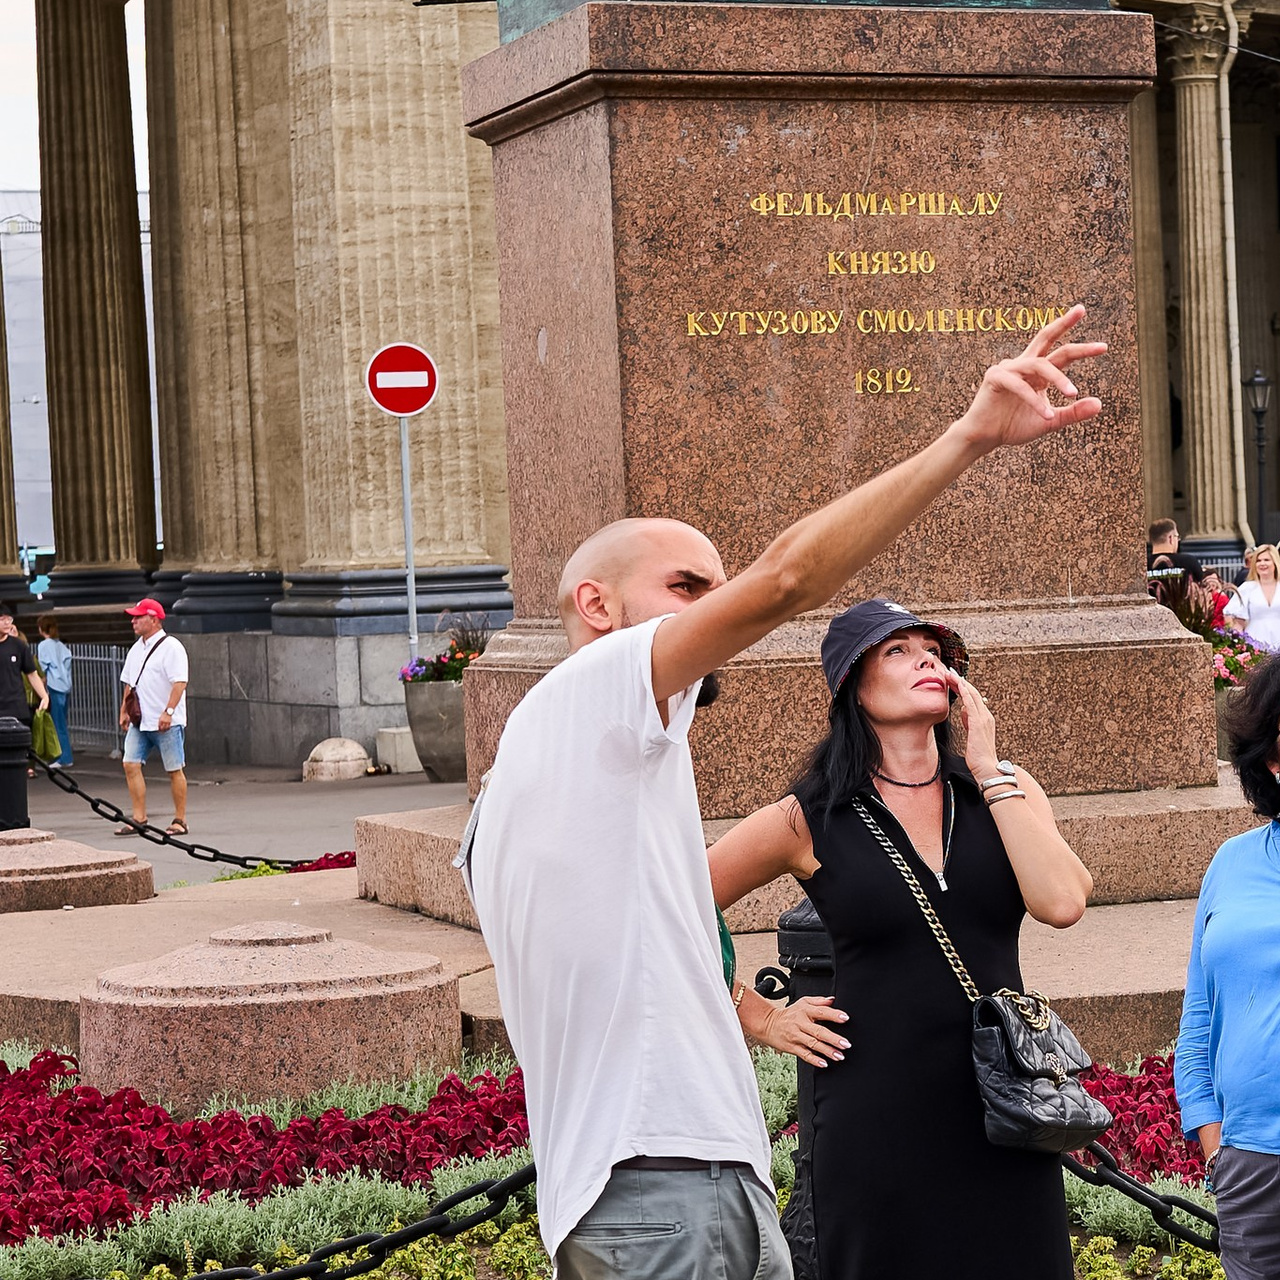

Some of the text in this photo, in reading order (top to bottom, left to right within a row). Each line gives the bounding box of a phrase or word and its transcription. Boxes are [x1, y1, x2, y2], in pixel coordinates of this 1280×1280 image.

[749, 191, 1003, 222] ФЕЛЬДМАРШАЛУ
[827, 250, 936, 275] КНЯЗЮ
[687, 309, 844, 336] КУТУЗОВУ
